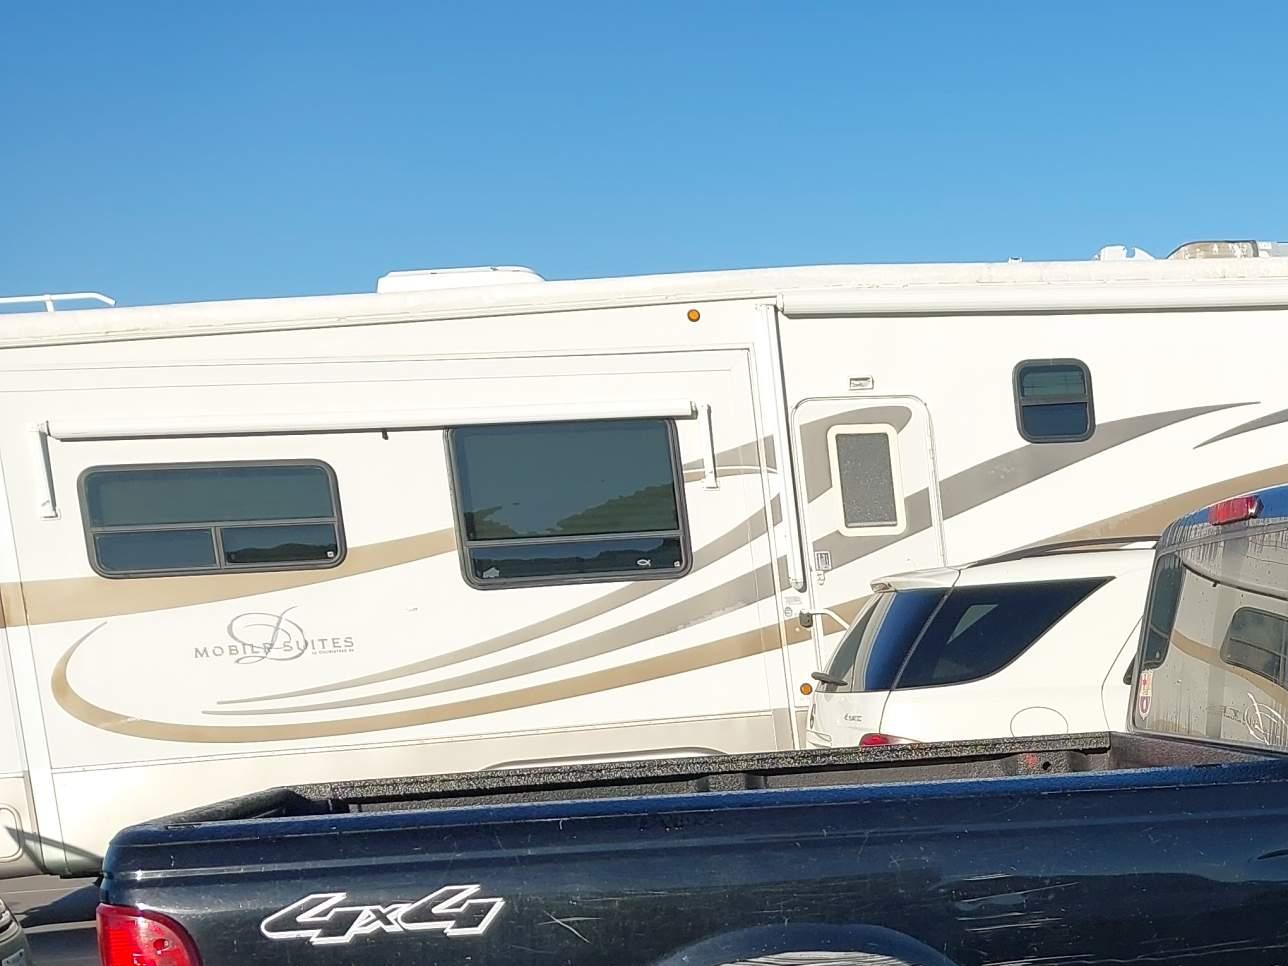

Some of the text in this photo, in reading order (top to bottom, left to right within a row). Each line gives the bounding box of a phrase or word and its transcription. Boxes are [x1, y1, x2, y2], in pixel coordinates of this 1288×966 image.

[194, 643, 273, 659] MOBILE
[283, 636, 354, 652] SUITES
[260, 884, 505, 945] 4x4
